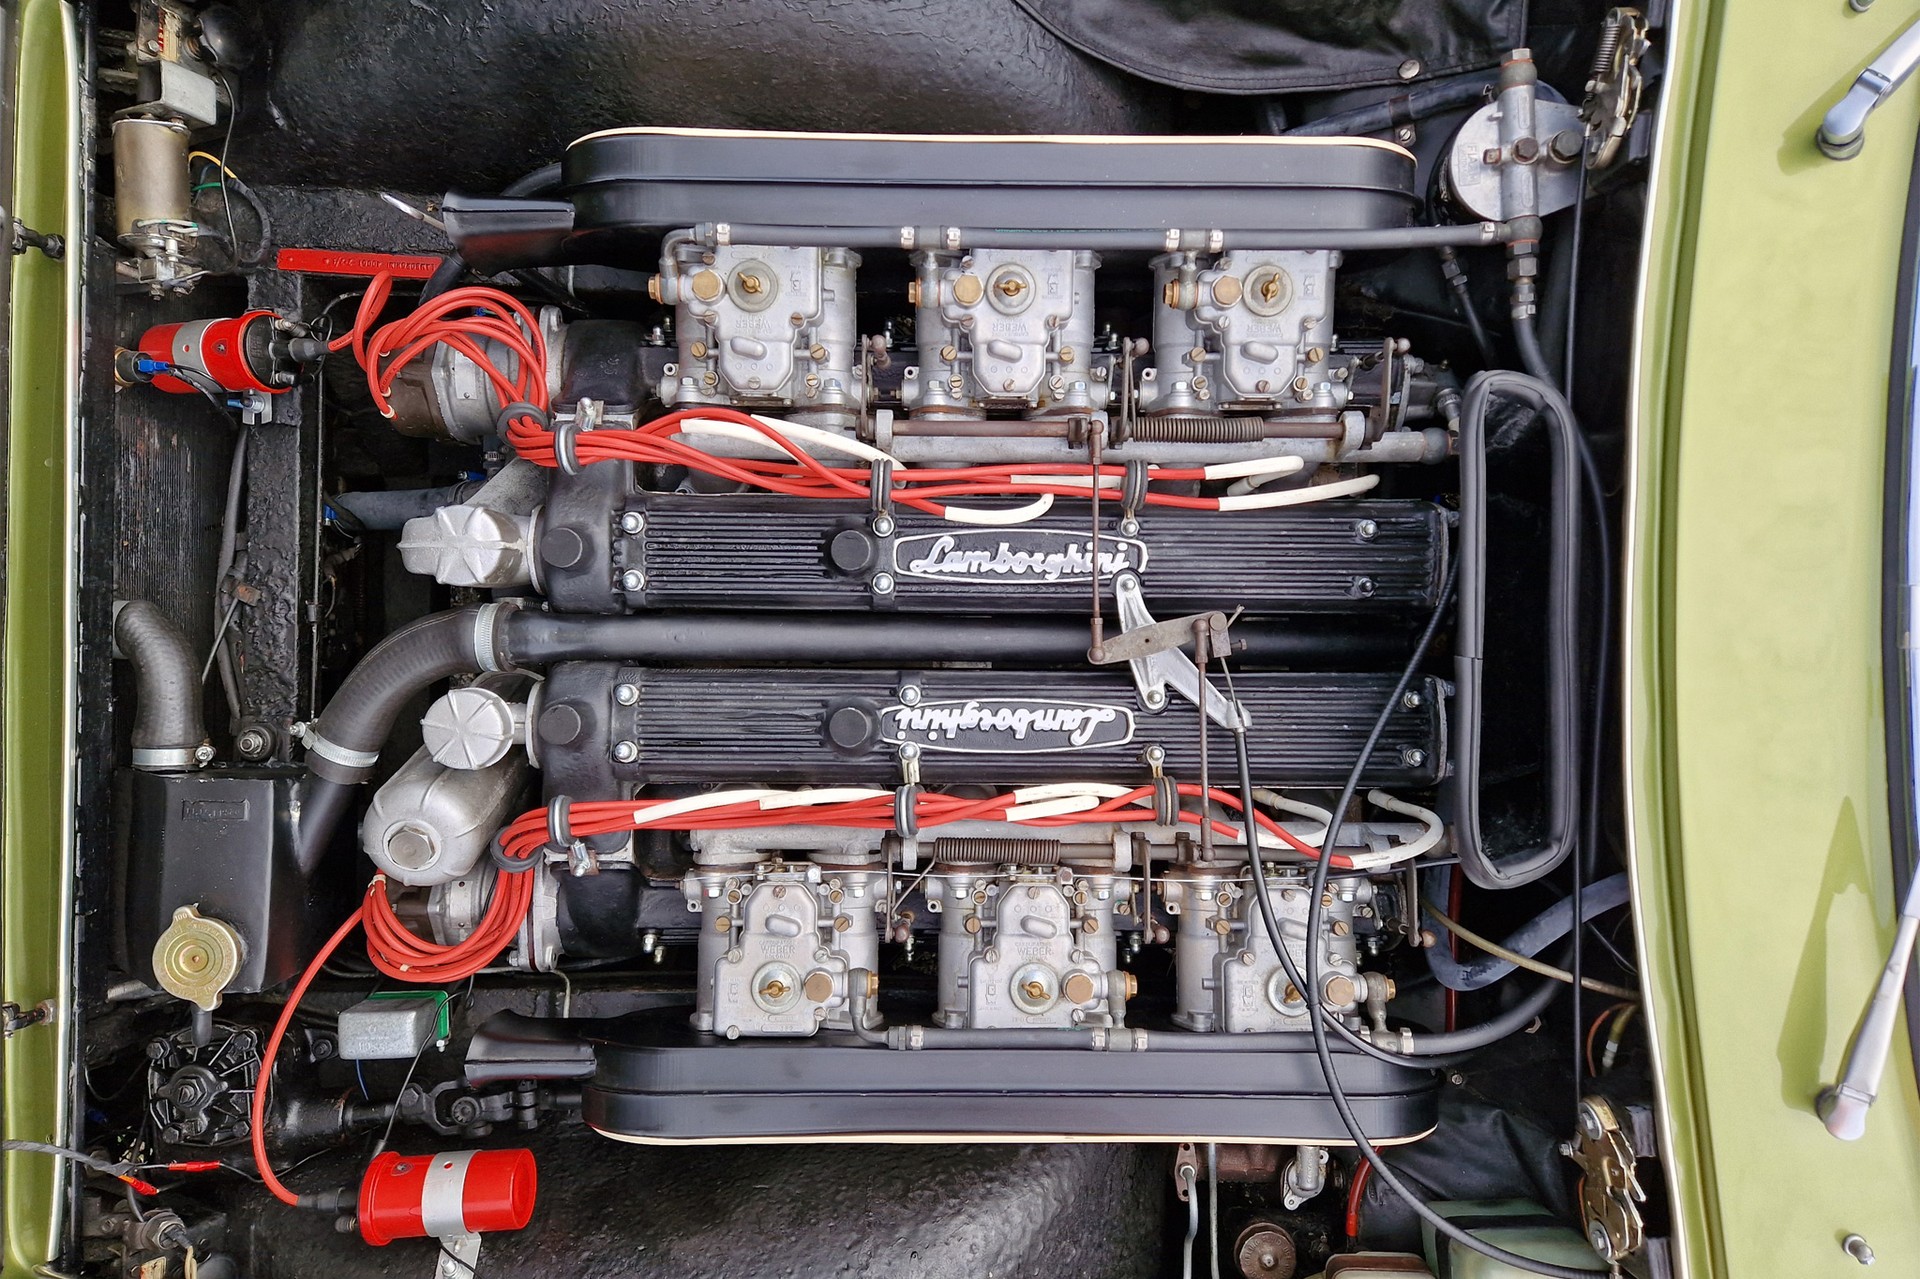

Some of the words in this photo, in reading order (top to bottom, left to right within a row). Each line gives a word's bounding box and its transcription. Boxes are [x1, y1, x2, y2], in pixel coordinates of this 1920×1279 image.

[992, 322, 1028, 332] WEBER
[909, 535, 1130, 580] Lamborghini
[894, 701, 1116, 747] Lamborghini
[760, 944, 796, 954] WEBER
[1017, 946, 1053, 956] WEBER
